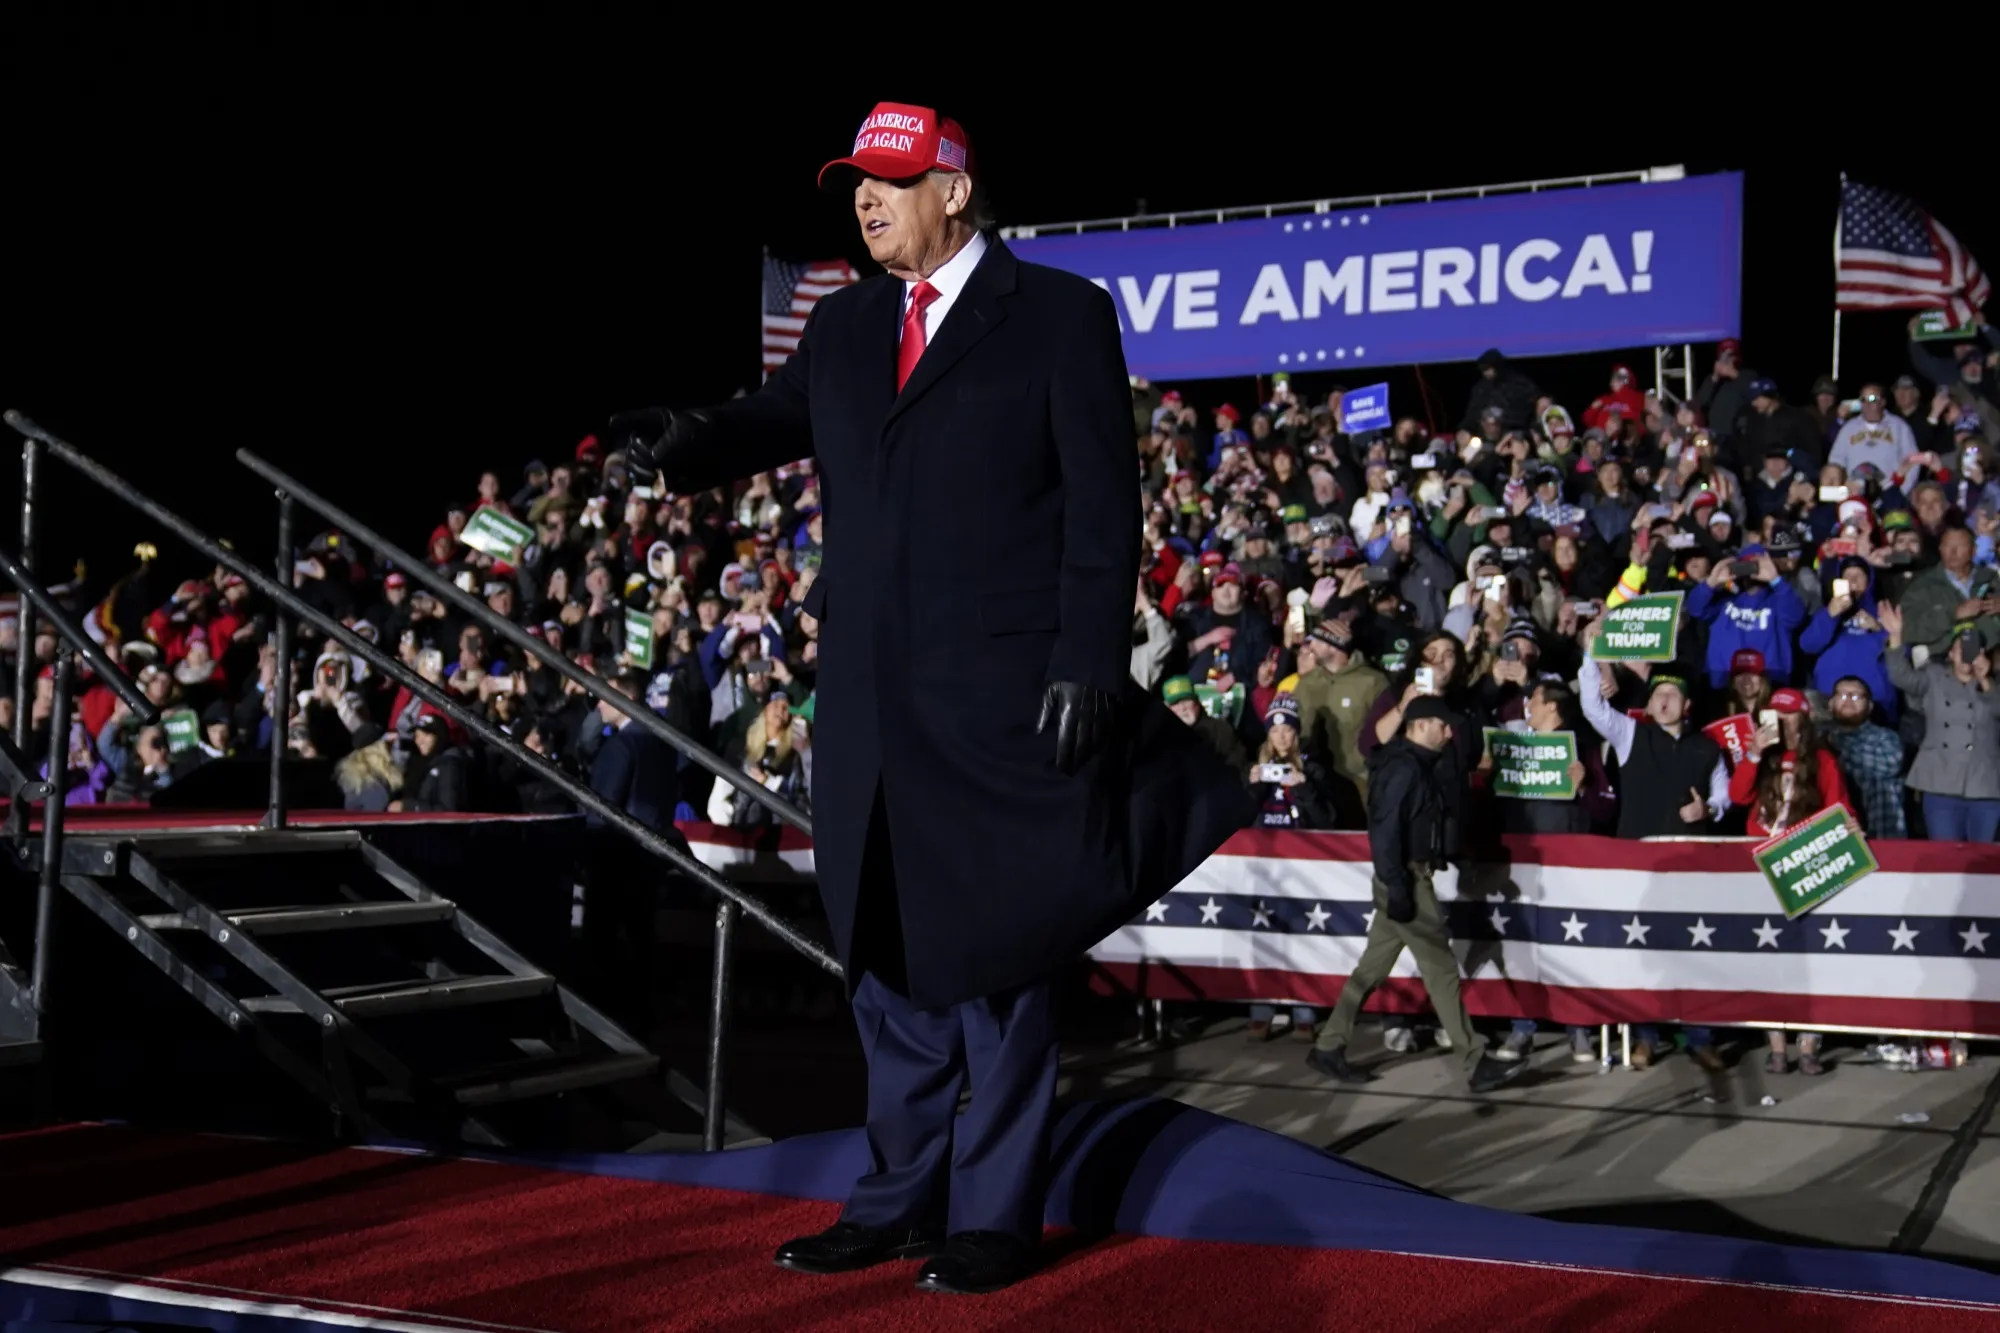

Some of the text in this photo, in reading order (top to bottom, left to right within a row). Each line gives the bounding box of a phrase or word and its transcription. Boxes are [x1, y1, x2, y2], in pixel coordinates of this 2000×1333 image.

[868, 112, 924, 134] AMERICA
[871, 132, 915, 153] AGAIN
[1090, 230, 1655, 334] VE AMERICA!
[1605, 607, 1673, 622] ARMERS
[1622, 621, 1646, 633] FOR
[1605, 632, 1662, 649] TRUMP!
[1516, 760, 1541, 771] FOR
[1501, 768, 1562, 786] TRUMP!
[1770, 823, 1850, 878] FARMERS
[1803, 852, 1830, 874] FOR
[1790, 851, 1856, 898] TRUMP!
